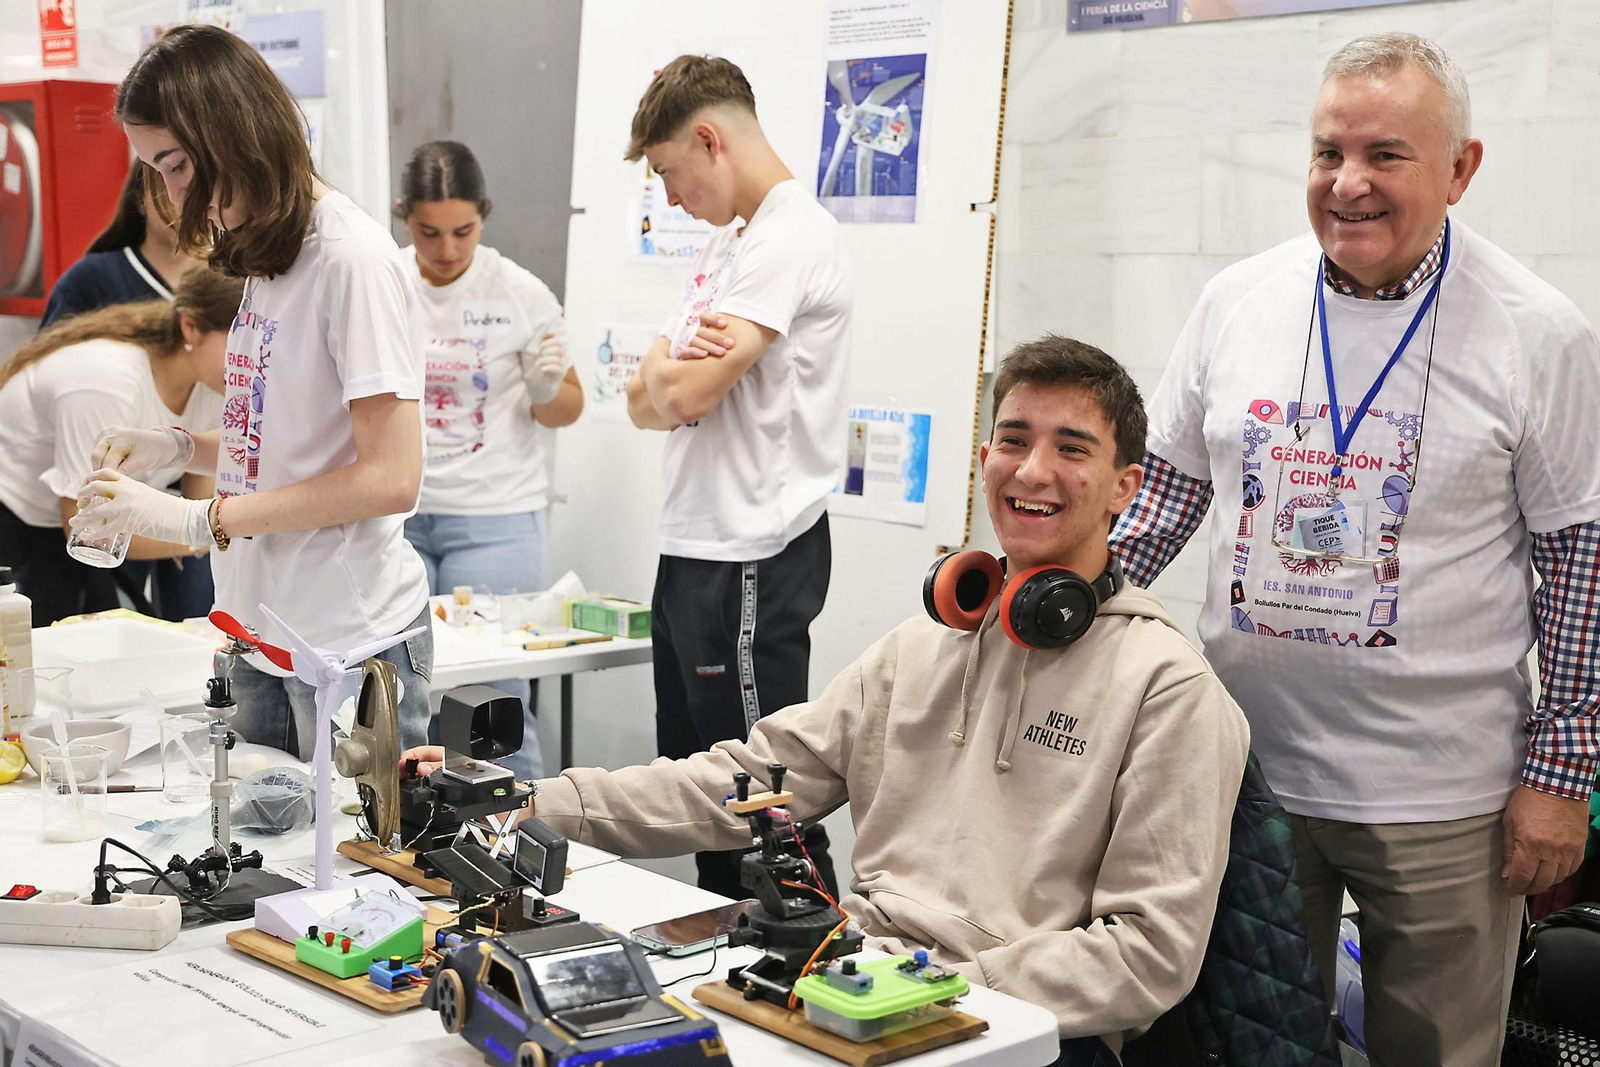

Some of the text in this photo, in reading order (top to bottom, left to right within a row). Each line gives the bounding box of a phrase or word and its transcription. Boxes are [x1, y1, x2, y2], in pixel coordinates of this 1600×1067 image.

[1086, 5, 1109, 15] FERIA
[1109, 3, 1121, 13] DE
[1122, 3, 1133, 12] LA
[1134, 0, 1168, 11] CIENCIA
[1270, 446, 1383, 471] GENERACIÓN
[1289, 469, 1357, 490] CIENIA
[1312, 522, 1340, 534] BEBIDA
[1313, 514, 1335, 526] TIQUE
[1263, 580, 1353, 600] IES. SAN ANTONIO
[1254, 599, 1280, 608] Bollullos
[1304, 606, 1333, 615] Condado
[1333, 609, 1361, 618] (Huelva)
[1045, 710, 1078, 734] NEW
[1023, 724, 1087, 756] ATHLETES
